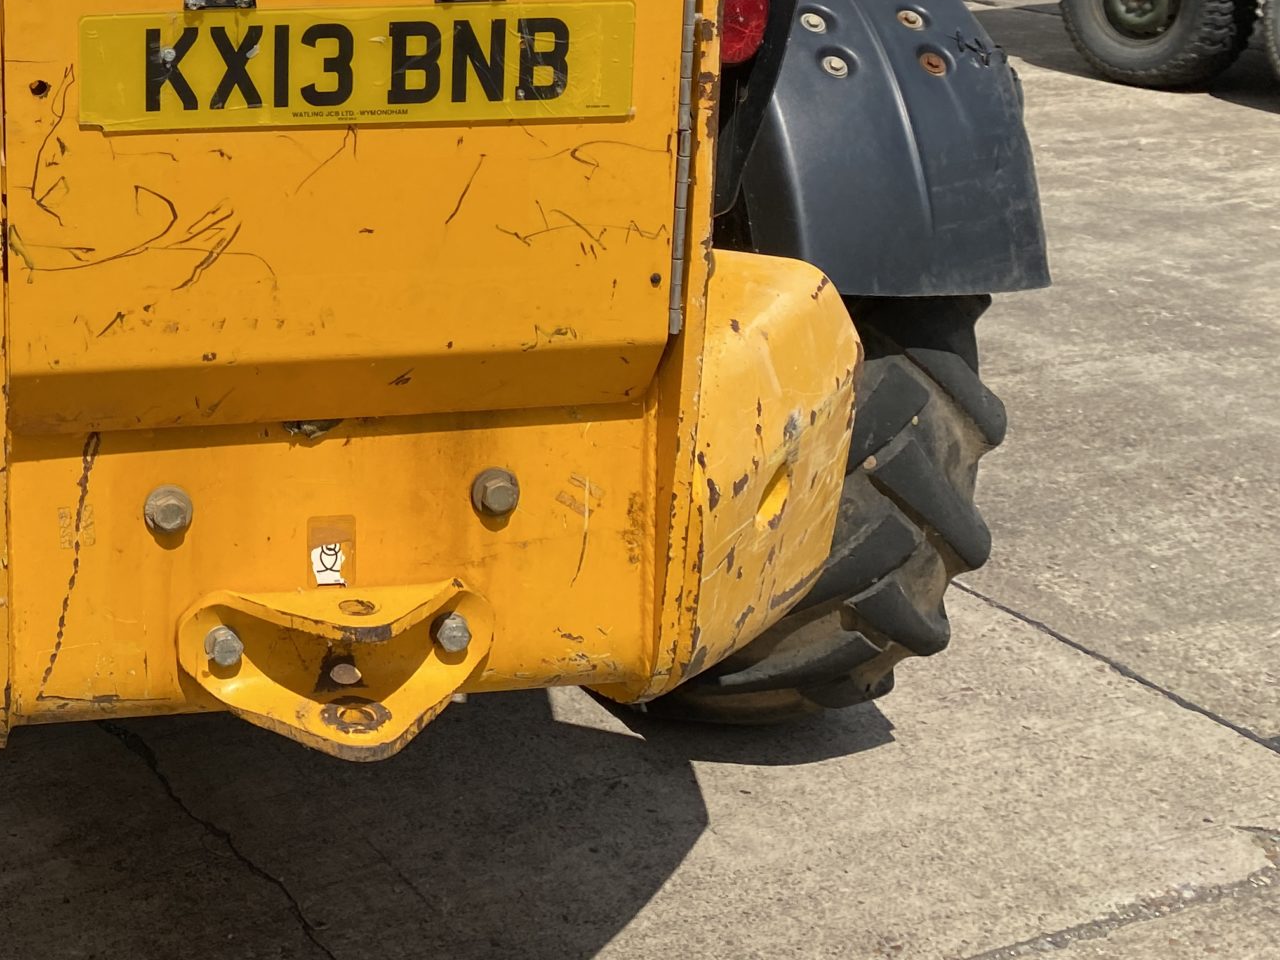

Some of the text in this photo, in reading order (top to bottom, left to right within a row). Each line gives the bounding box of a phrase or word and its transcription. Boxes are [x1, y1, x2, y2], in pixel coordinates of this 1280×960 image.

[145, 17, 569, 112] KX13 BNB
[292, 110, 324, 118] WATLING
[325, 110, 340, 118] JCB
[359, 108, 408, 116] WYMONDHAM
